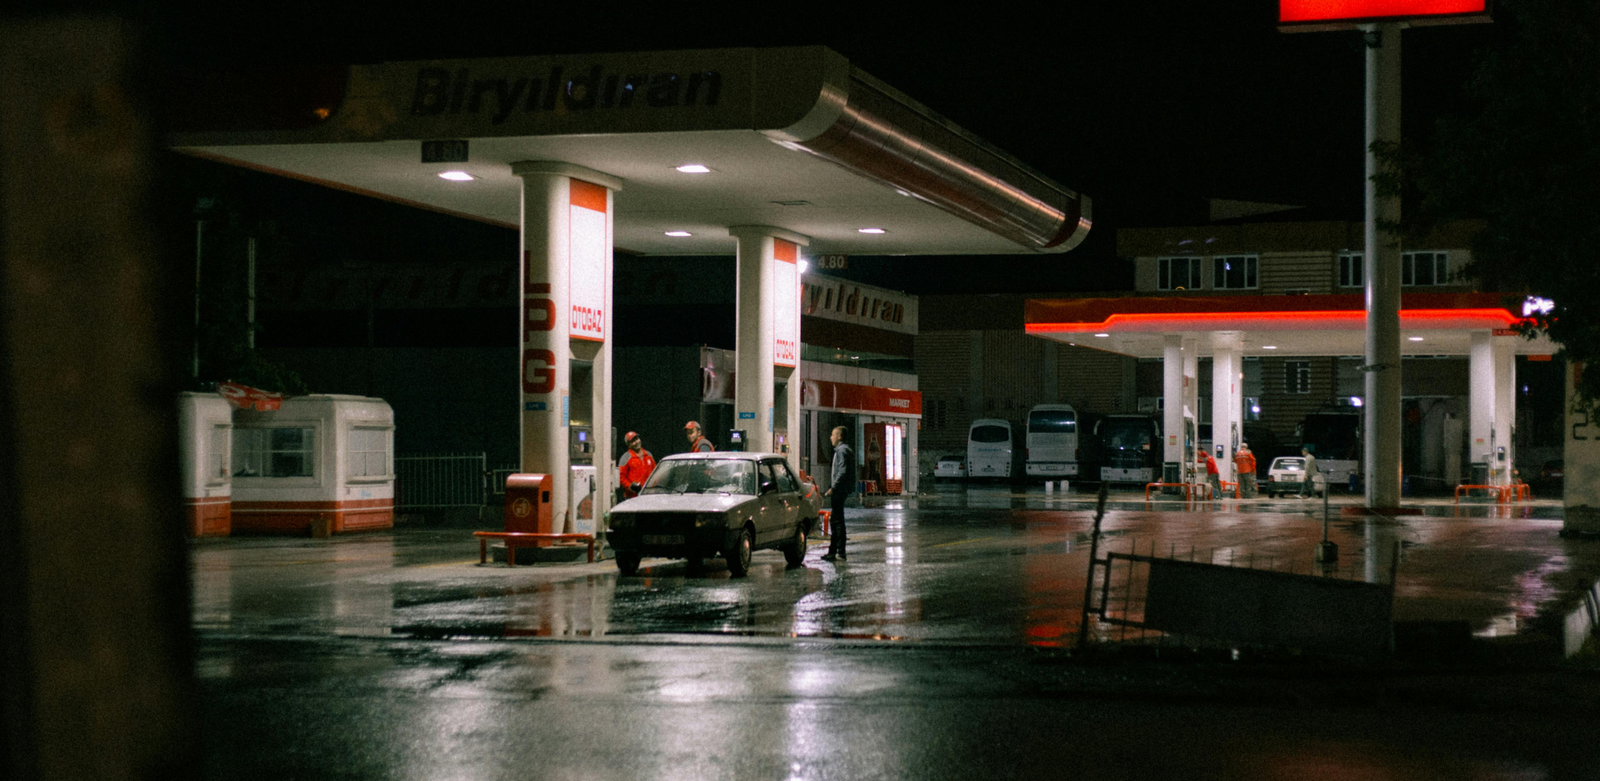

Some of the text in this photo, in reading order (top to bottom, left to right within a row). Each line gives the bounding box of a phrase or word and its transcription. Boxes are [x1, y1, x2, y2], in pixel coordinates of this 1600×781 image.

[818, 255, 845, 269] 4.80
[523, 250, 556, 394] LPG
[572, 305, 602, 333] OTOGAZ
[889, 398, 910, 409] MARKET
